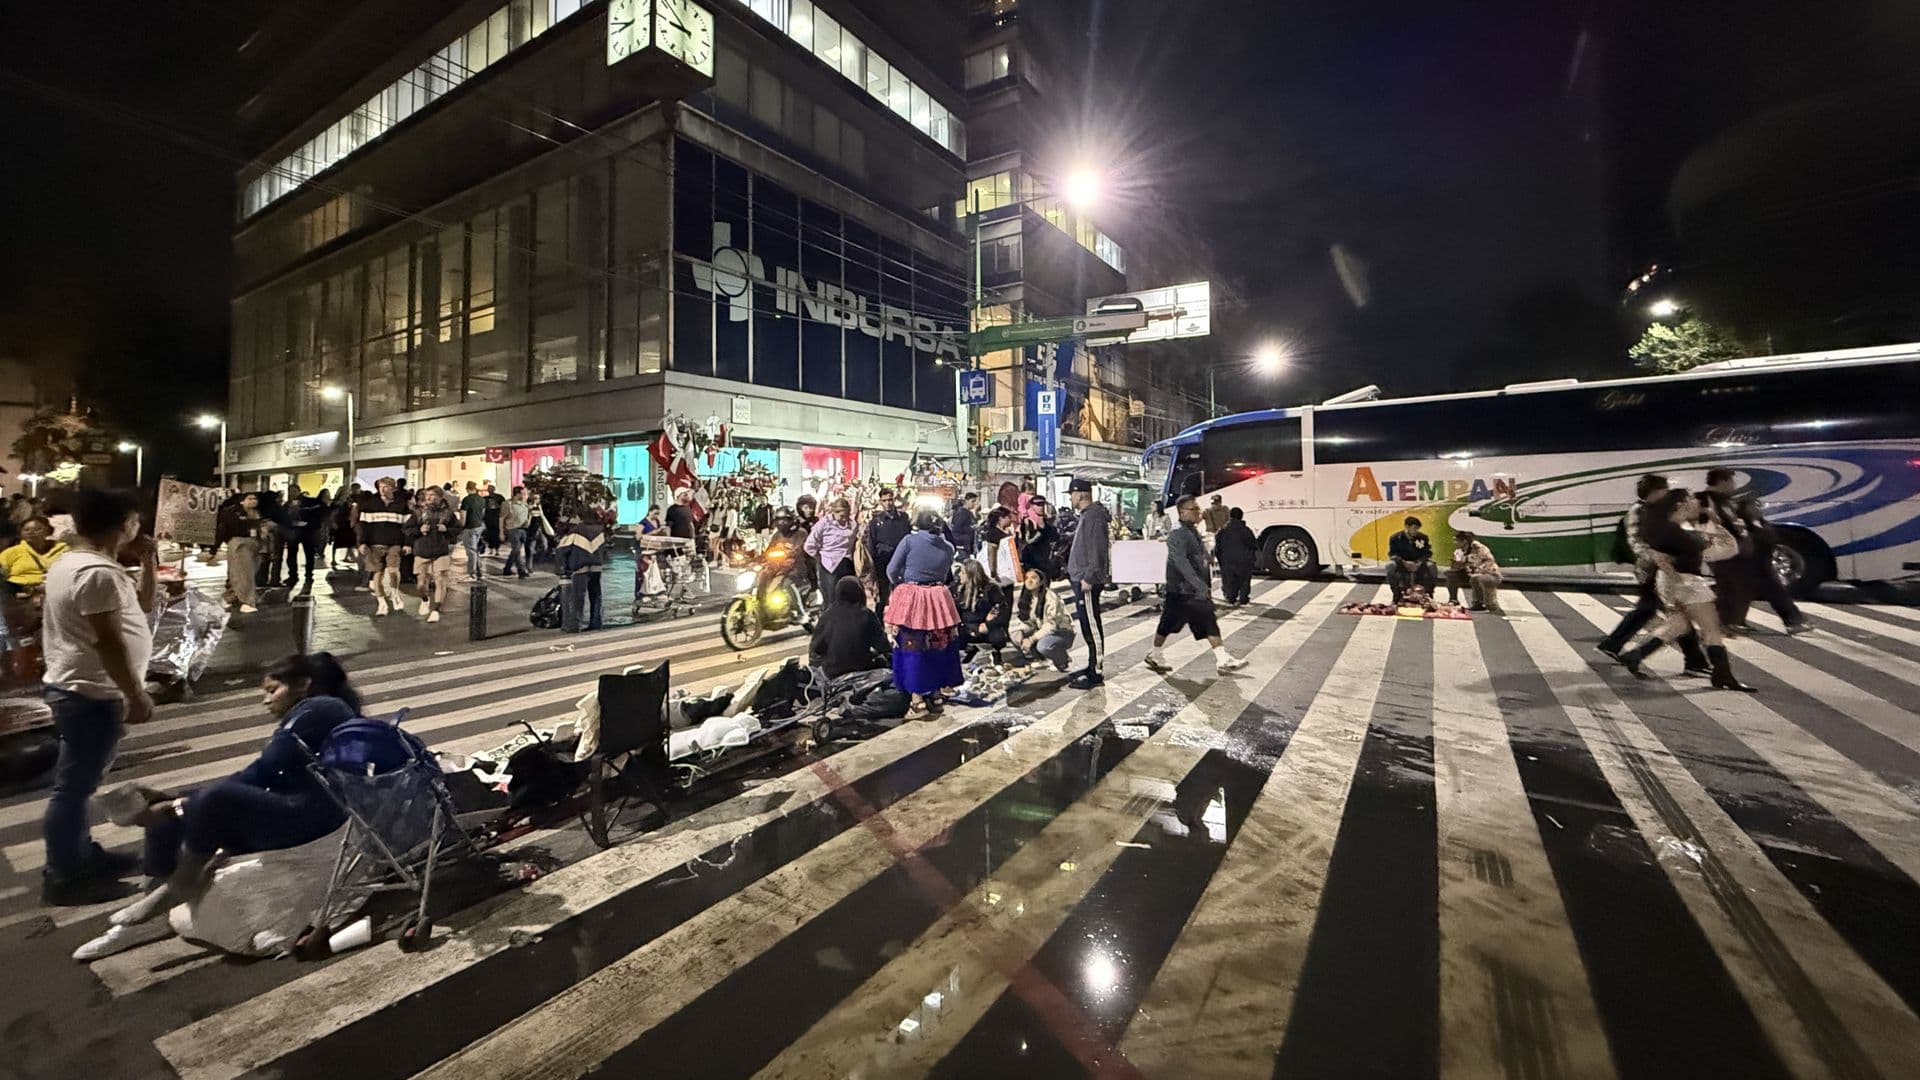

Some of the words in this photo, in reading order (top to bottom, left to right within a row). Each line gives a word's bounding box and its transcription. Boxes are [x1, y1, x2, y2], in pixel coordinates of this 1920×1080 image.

[775, 265, 961, 360] INBURSA
[657, 465, 665, 500] INISO
[1347, 466, 1516, 501] ATEMPAN
